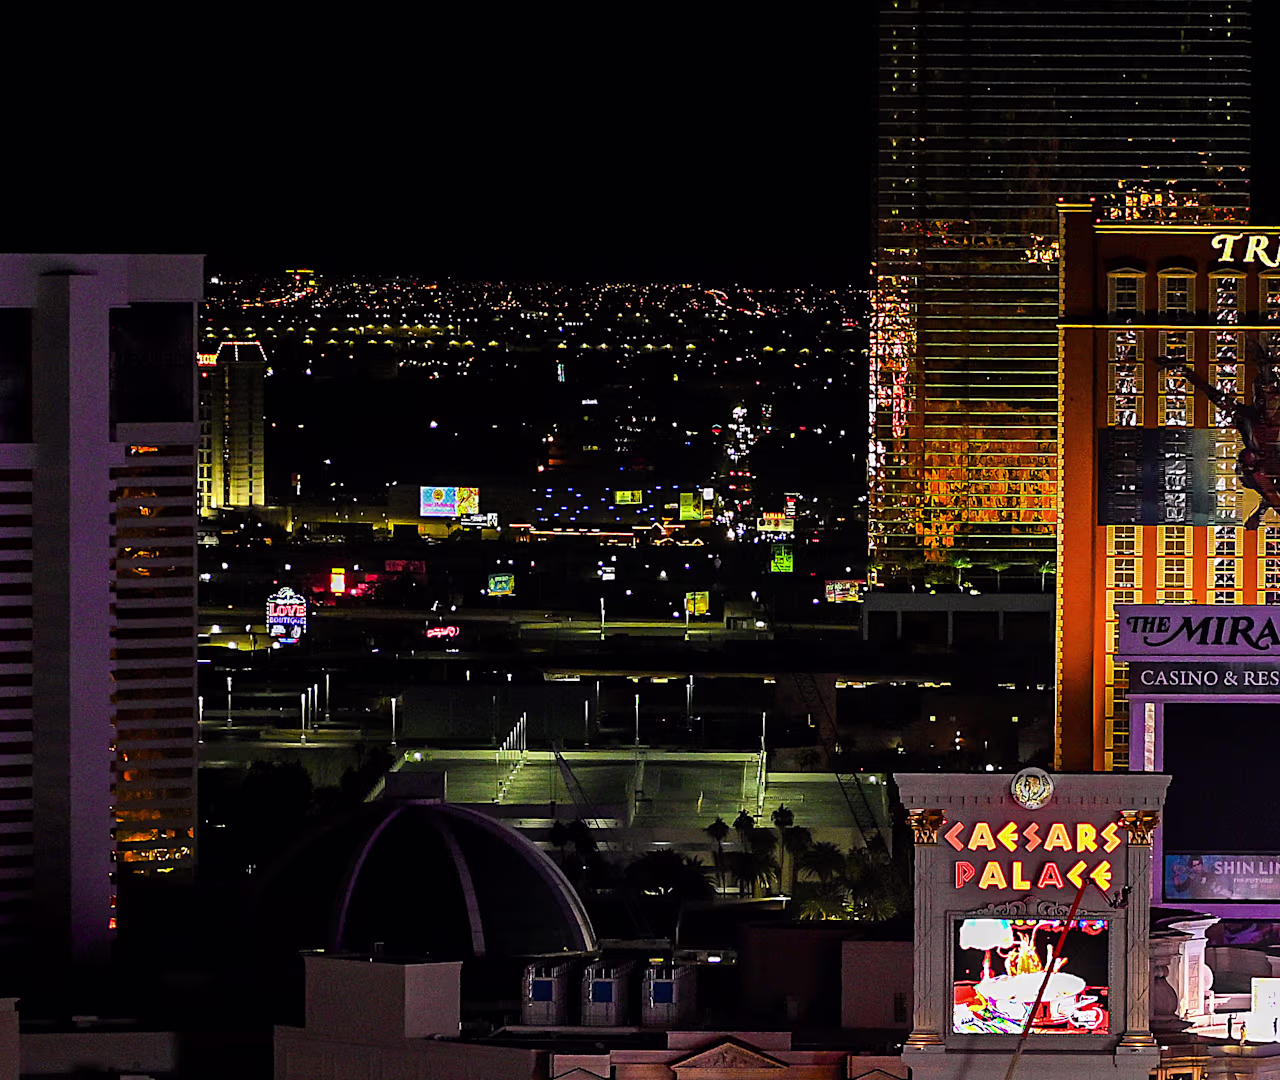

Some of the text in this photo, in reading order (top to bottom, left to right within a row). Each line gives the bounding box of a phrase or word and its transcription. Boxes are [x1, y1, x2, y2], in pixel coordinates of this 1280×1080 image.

[268, 603, 306, 617] LOVE
[269, 617, 306, 625] BOUTIQUE
[1126, 616, 1171, 634] THE
[1140, 670, 1219, 686] CASINO
[1223, 670, 1238, 686] &
[943, 821, 1122, 854] CAESARS
[954, 859, 1113, 891] PALACE
[1214, 861, 1254, 875] SHIN
